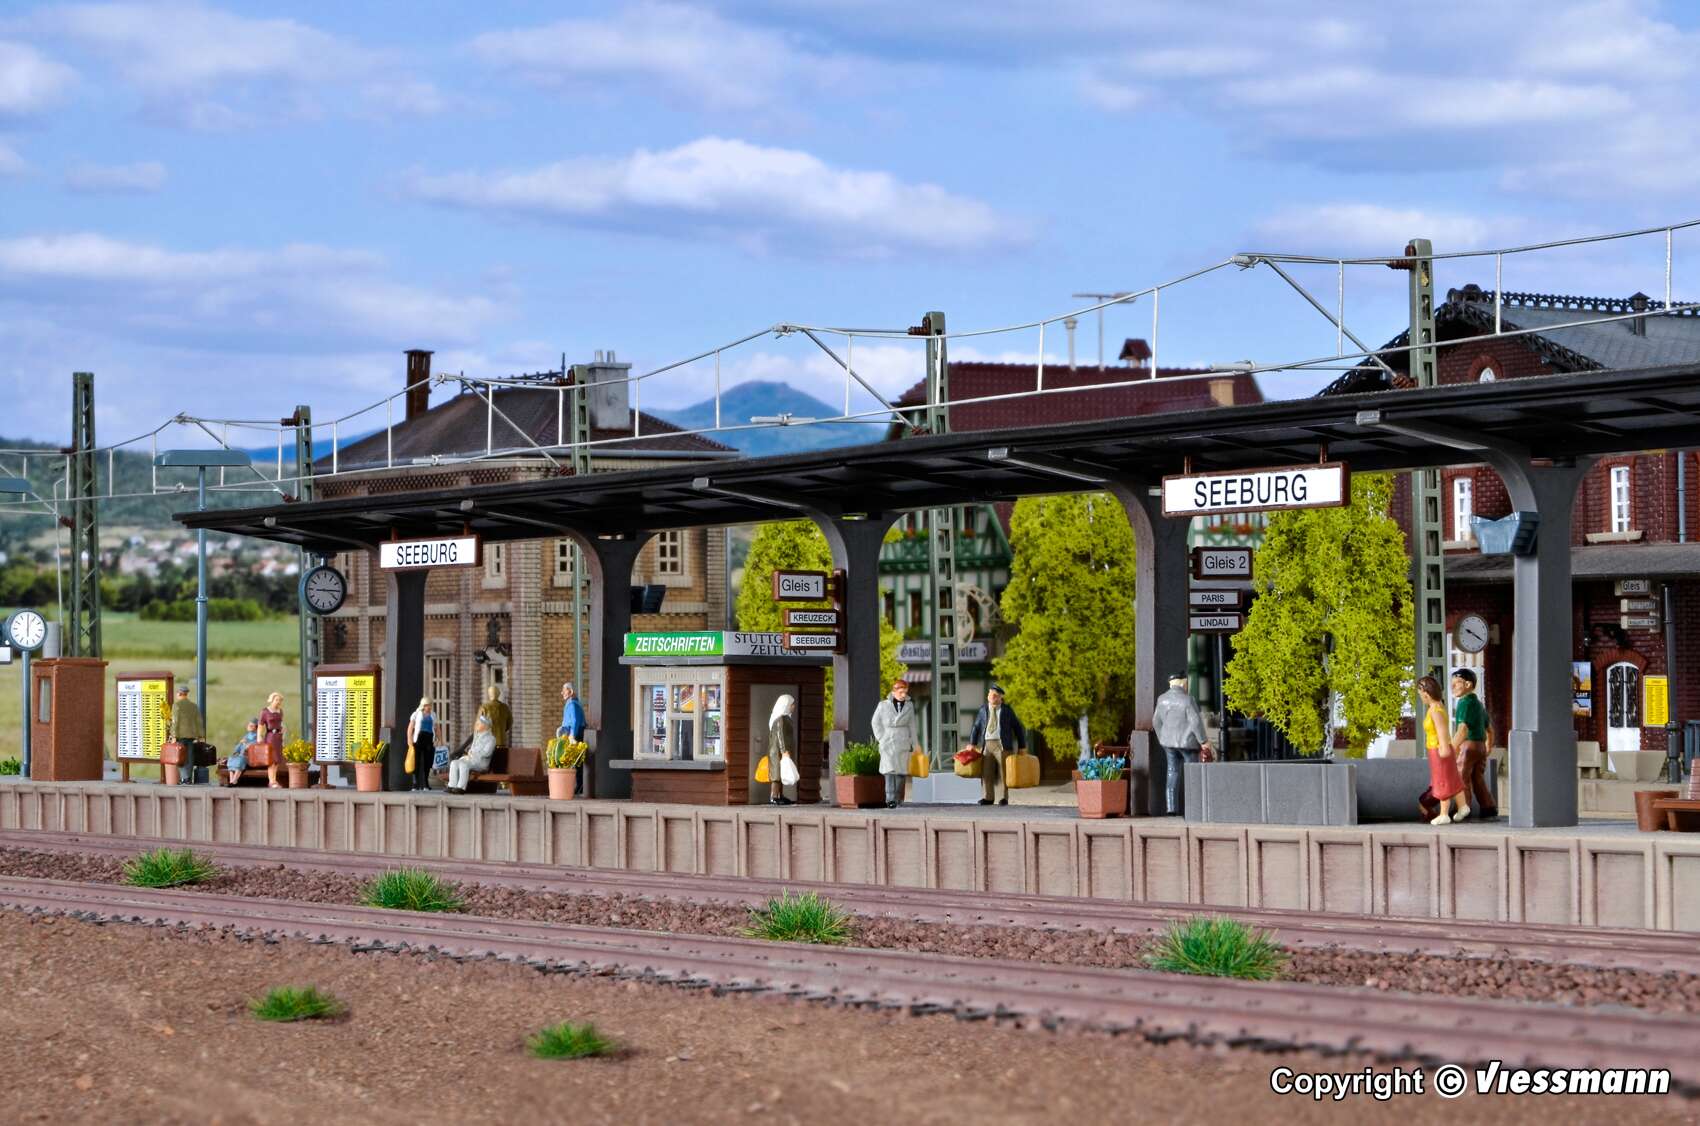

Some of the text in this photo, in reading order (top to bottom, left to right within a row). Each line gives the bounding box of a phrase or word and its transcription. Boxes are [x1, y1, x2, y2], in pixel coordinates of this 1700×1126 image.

[1194, 474, 1307, 508] SEEBURG
[396, 542, 458, 565] SEEBURG
[1205, 555, 1247, 569] Gleis 2
[781, 578, 820, 593] Gleis 1
[1201, 594, 1225, 603] PARIS
[793, 614, 834, 622] KREUZECK
[1199, 618, 1229, 627] LINDAU
[635, 636, 716, 652] ZEITSCHRIFTEN
[795, 637, 832, 645] SEEBURG
